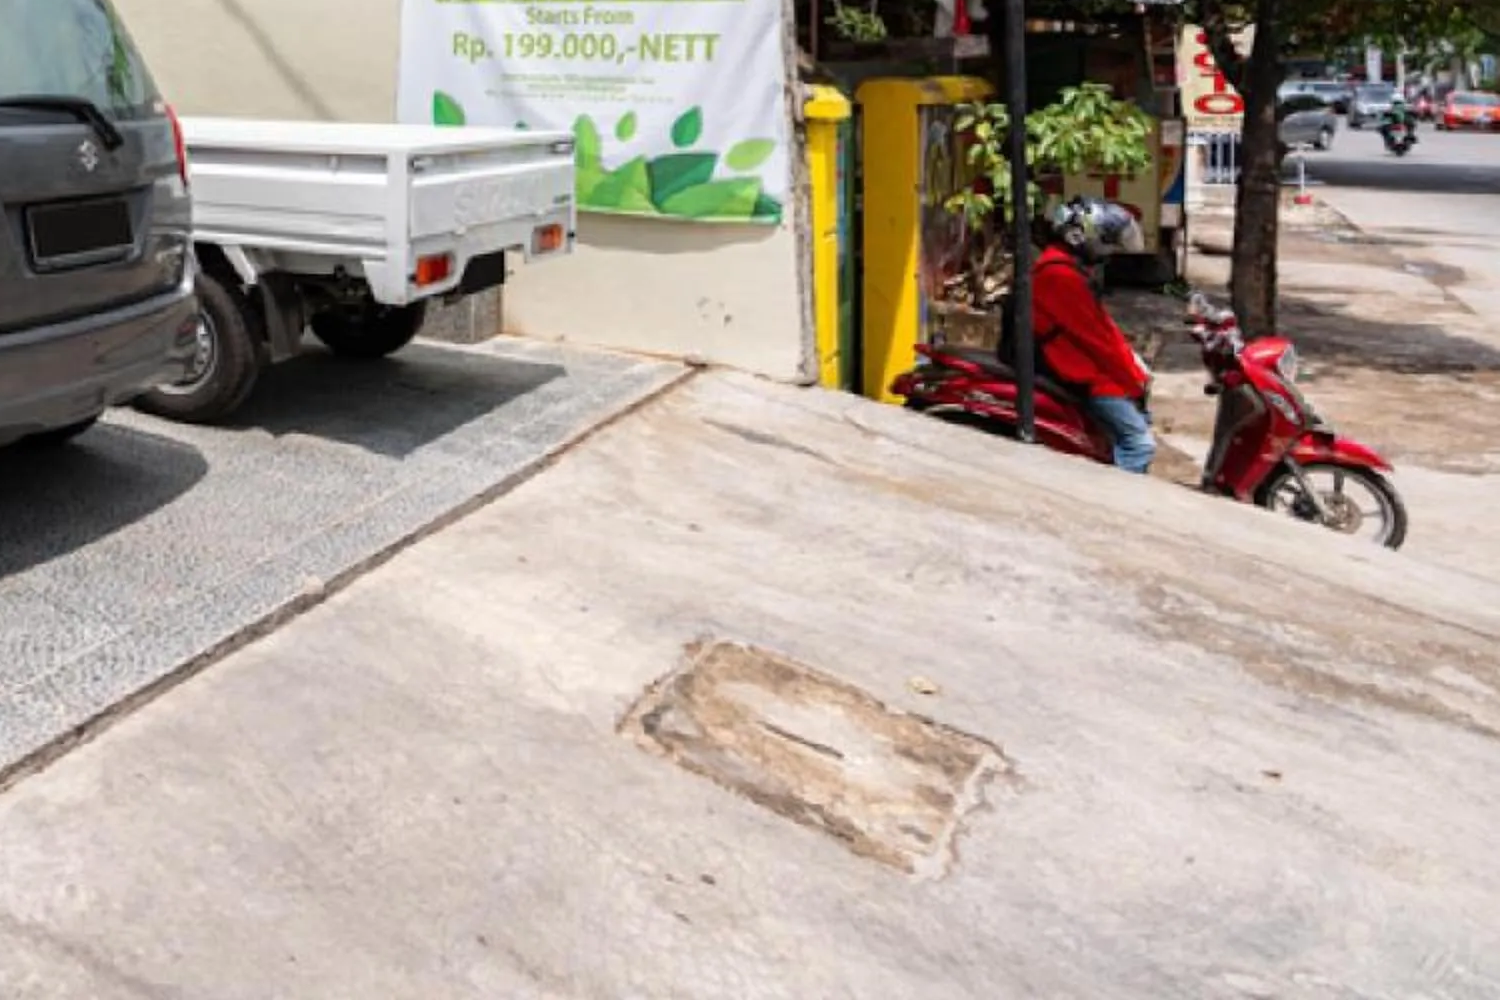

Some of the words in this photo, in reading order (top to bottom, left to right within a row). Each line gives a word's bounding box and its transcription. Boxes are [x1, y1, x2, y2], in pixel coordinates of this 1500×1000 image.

[525, 8, 579, 26] Starts
[584, 8, 634, 26] From
[452, 33, 494, 64] Rp.
